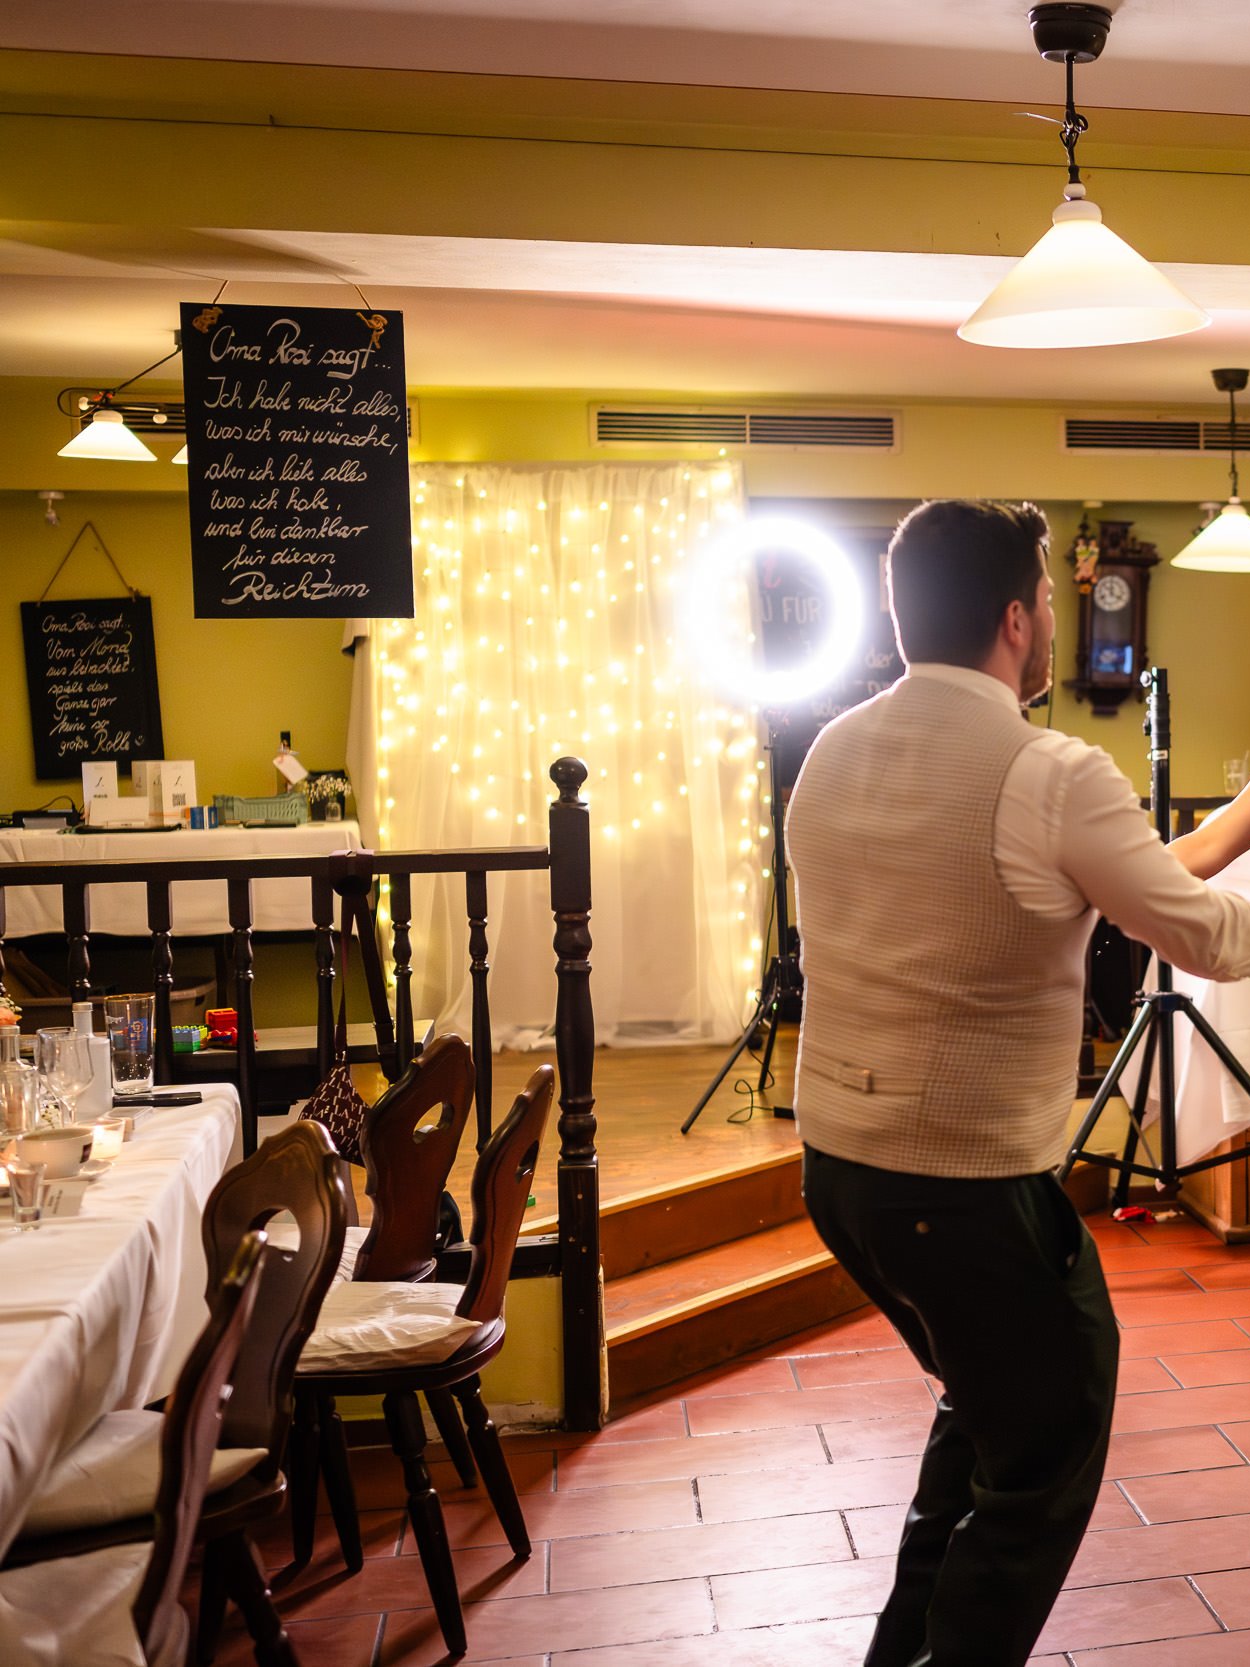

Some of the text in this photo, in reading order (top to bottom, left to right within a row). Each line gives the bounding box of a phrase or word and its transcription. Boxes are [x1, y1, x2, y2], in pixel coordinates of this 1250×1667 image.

[210, 325, 262, 362] Oma
[267, 318, 314, 365] Rosi
[203, 376, 401, 422] Ich habe nicht alles,
[247, 418, 271, 442] ich
[278, 425, 310, 443] mir
[312, 421, 399, 455] wünsche,
[204, 453, 368, 482] aber ich liebe alles
[249, 488, 280, 511] ich
[204, 516, 369, 540] und bin dankbar
[222, 544, 336, 571] für diesen
[221, 569, 371, 605] Reichtum
[42, 615, 69, 633] Oma
[46, 638, 76, 660] Vom
